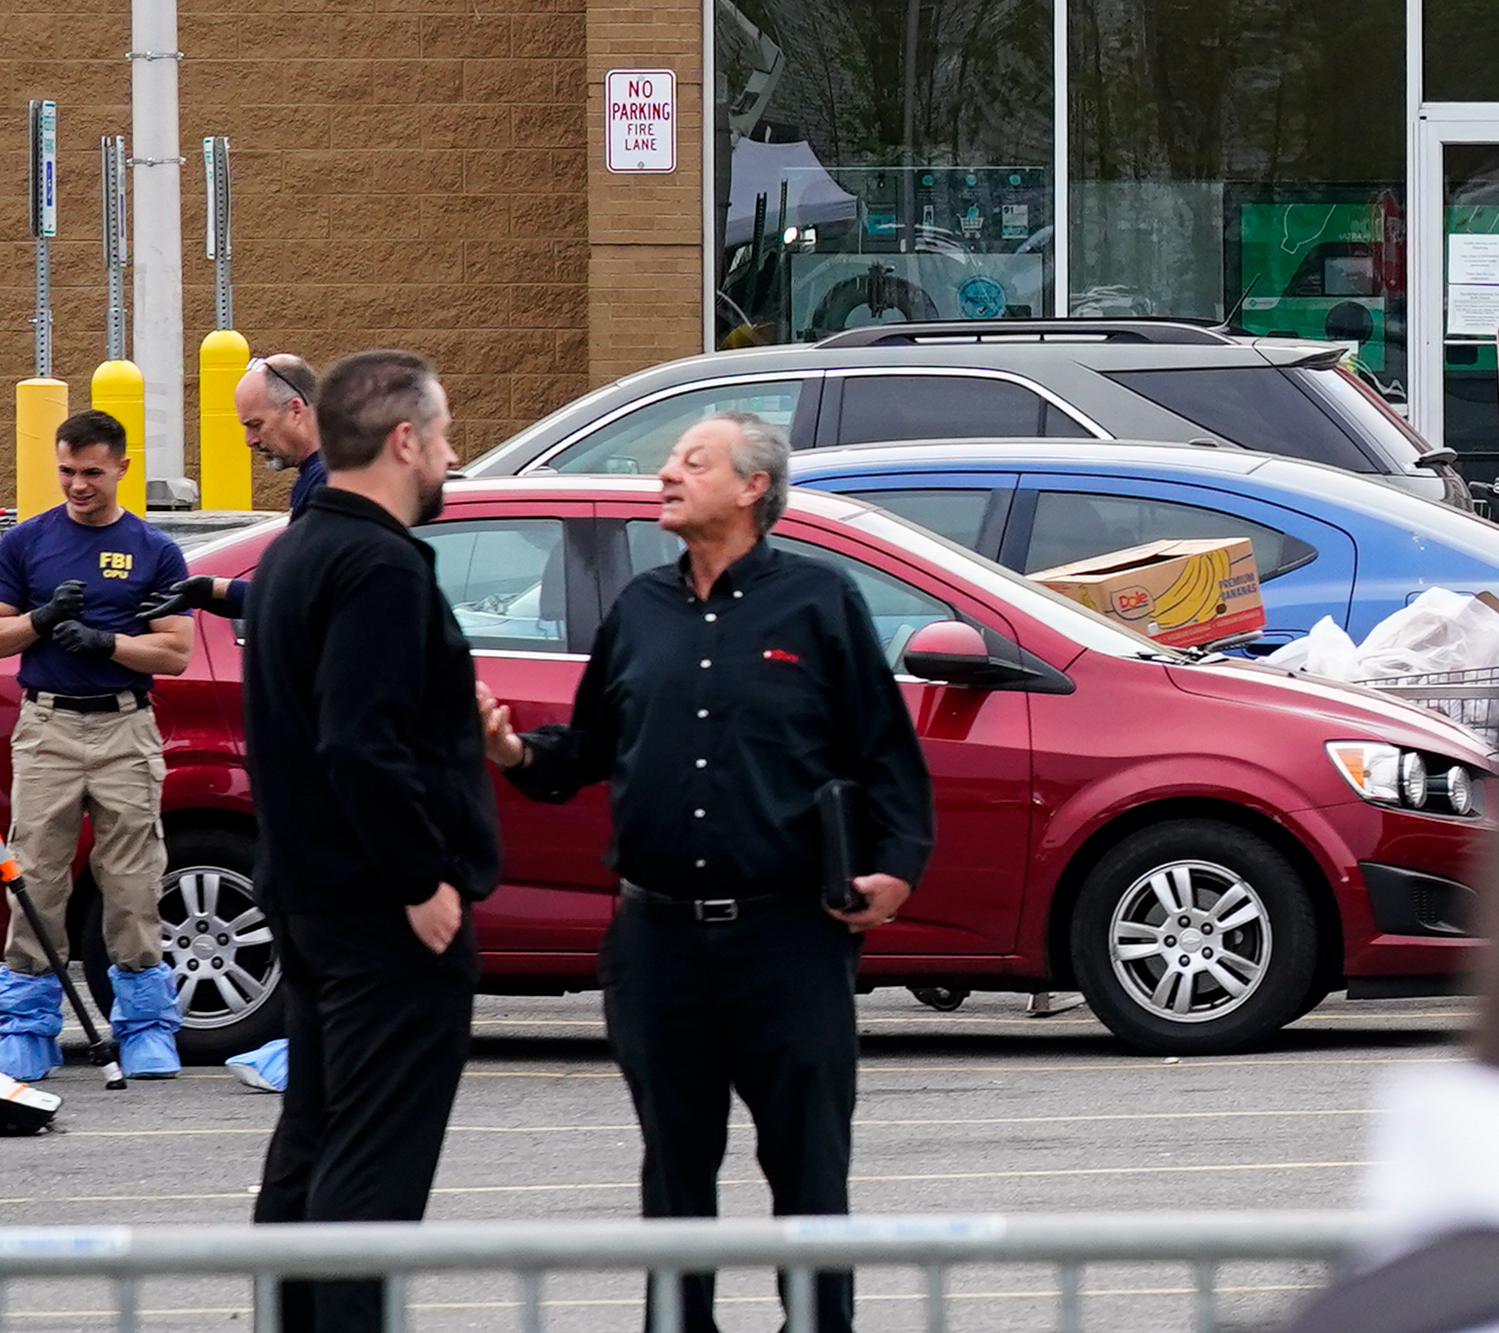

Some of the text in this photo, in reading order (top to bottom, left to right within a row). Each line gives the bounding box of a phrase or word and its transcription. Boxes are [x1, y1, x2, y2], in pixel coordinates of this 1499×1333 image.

[629, 80, 653, 98] NO
[612, 102, 670, 121] PARKING
[627, 123, 654, 136] FIRE
[625, 138, 657, 151] LANE
[99, 552, 133, 570] FBI
[1118, 592, 1149, 610] Dole
